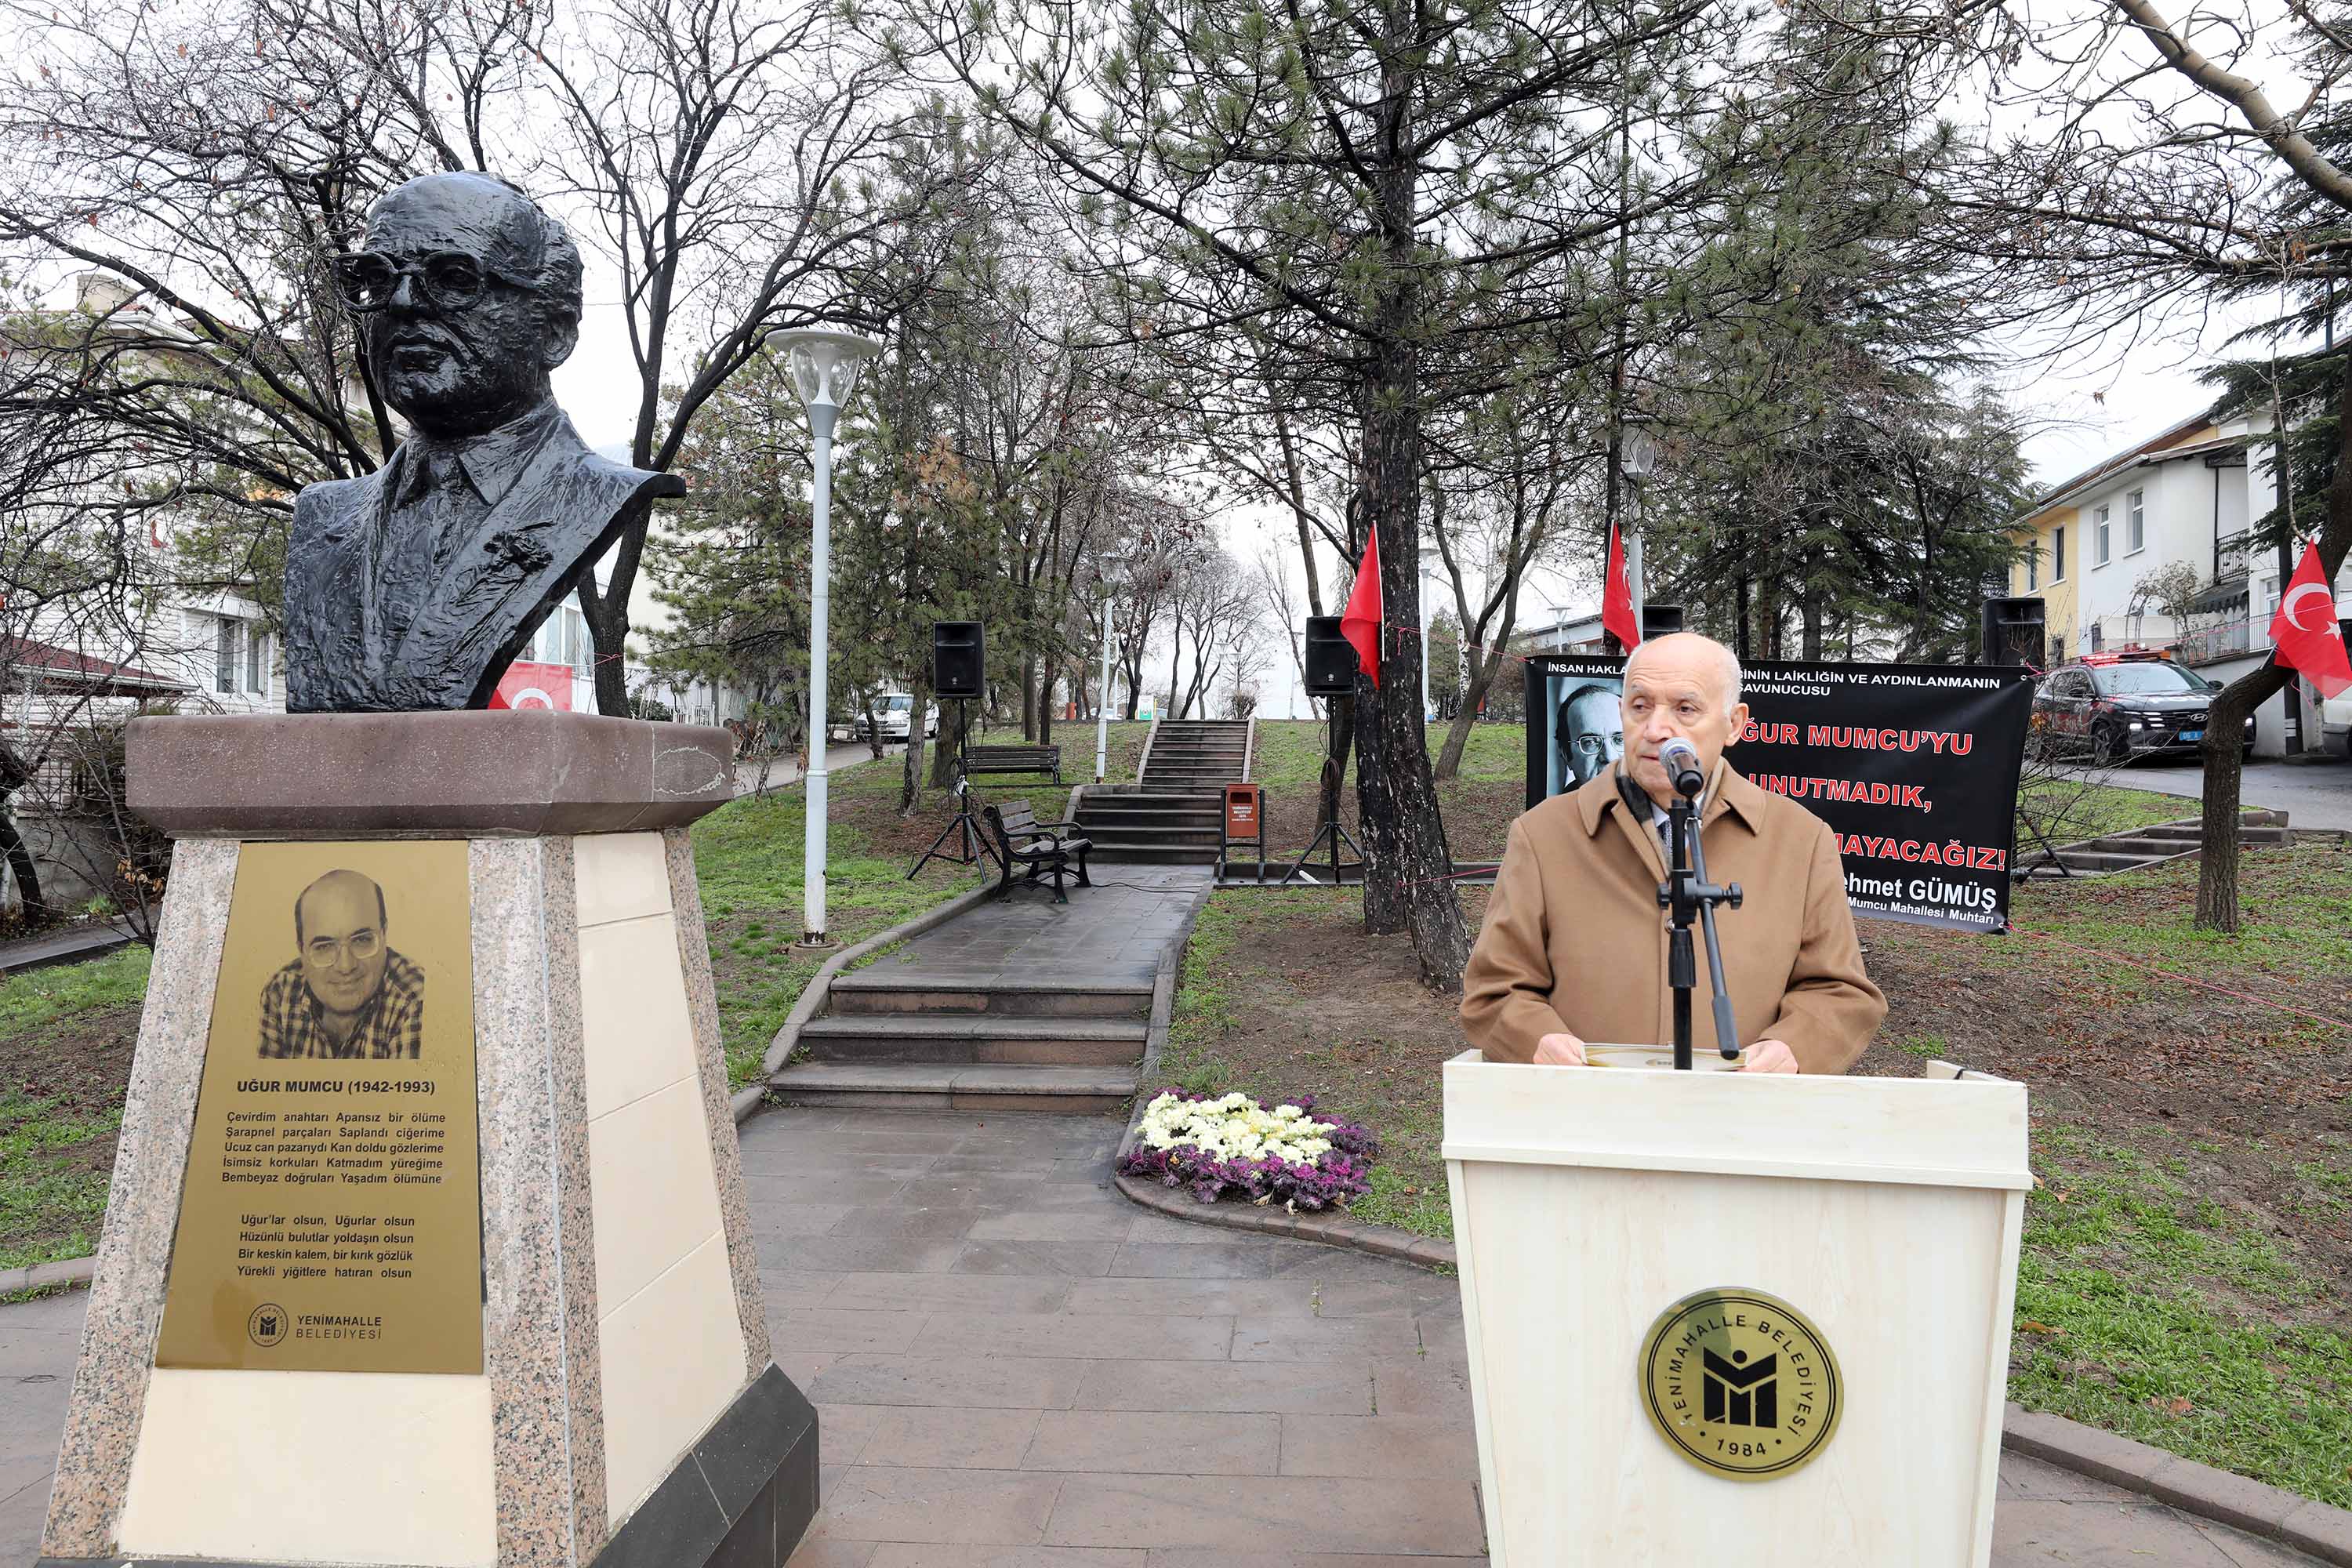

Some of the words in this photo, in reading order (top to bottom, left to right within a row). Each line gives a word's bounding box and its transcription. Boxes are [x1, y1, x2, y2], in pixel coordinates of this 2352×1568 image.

[1548, 661, 1584, 674] İNSAN
[1774, 670, 1845, 684] LAİKLİĞİN
[1848, 673, 1868, 684] VE
[1871, 674, 2001, 689] AYDINLANMANIN
[1807, 724, 1973, 756] MUMCU’YU
[1908, 877, 1998, 914] GÜMÜŞ
[1848, 896, 1887, 911] Mumcu
[1890, 902, 1944, 919] Mahallesi
[1949, 909, 1994, 925] Muhtarı
[237, 1078, 281, 1093] UĞUR
[285, 1080, 343, 1093] MUMCU
[347, 1080, 435, 1096] (1942-1993)
[227, 1111, 276, 1124] Çevirdim
[283, 1112, 329, 1123] anahtarı
[336, 1112, 381, 1125] Apansız
[388, 1112, 405, 1123] bir
[411, 1112, 446, 1123] ölüme
[225, 1126, 275, 1139] Şarapnel
[282, 1127, 332, 1139] parçaları
[339, 1127, 388, 1140] Saplandı
[396, 1127, 445, 1141] ciğerime
[223, 1142, 252, 1153] Ucuz
[254, 1144, 274, 1152] can
[277, 1142, 327, 1155] pazarıydı
[330, 1142, 352, 1152] Kan
[354, 1142, 387, 1153] doldu
[389, 1142, 445, 1156] gözlerime
[223, 1154, 262, 1167] İsimsiz
[269, 1156, 318, 1167] korkuları
[326, 1157, 383, 1168] Katmadım
[390, 1157, 443, 1171] yüreğime
[221, 1171, 279, 1185] Bembeyaz
[284, 1172, 335, 1185] doğruları
[340, 1172, 387, 1186] Yaşadım
[393, 1173, 442, 1185] ölümüne
[241, 1214, 286, 1227] Uğur’lar
[292, 1214, 327, 1227] olsun,
[335, 1214, 377, 1229] Uğurlar
[383, 1216, 415, 1226] olsun
[239, 1231, 285, 1243] Hüzünlü
[288, 1232, 330, 1243] bulutlar
[333, 1232, 379, 1246] yoldaşın
[383, 1232, 414, 1243] olsun
[238, 1248, 255, 1259] Bir
[256, 1248, 292, 1260] keskin
[295, 1249, 330, 1261] kalem,
[332, 1249, 349, 1260] bir
[350, 1250, 374, 1261] kırık
[376, 1250, 413, 1263] gözlük
[238, 1265, 275, 1276] Yürekli
[282, 1266, 327, 1279] yiğitlere
[334, 1266, 373, 1278] hatıran
[380, 1267, 412, 1279] olsun
[297, 1313, 382, 1327] YENİMAHALLE
[296, 1327, 382, 1340] BELEDİYESİ
[1664, 1315, 1746, 1424] YENİMAHALLE
[1758, 1320, 1817, 1437] BELEDİYESİ
[1717, 1439, 1767, 1457] 1984
